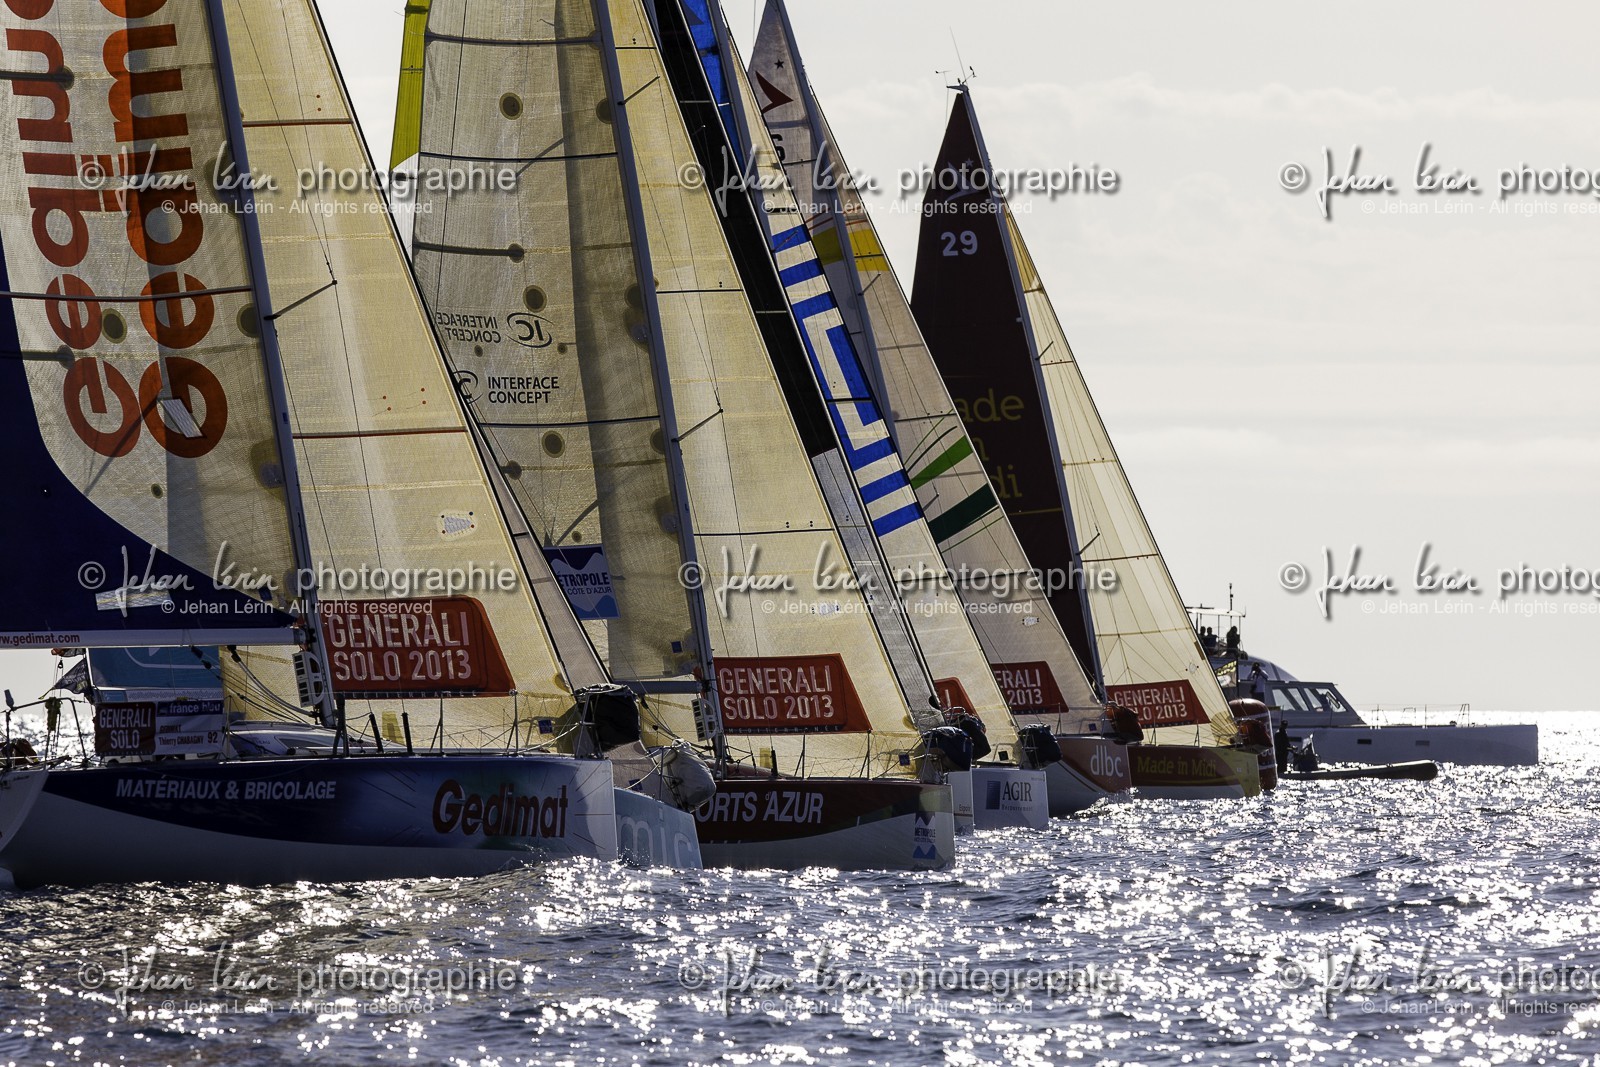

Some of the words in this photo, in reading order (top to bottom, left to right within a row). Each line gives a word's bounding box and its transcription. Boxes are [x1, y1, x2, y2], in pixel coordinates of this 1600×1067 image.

[940, 230, 978, 257] 29
[488, 376, 560, 390] INTERFACE
[488, 391, 552, 404] CONCEPT
[568, 586, 585, 596] CÔTE
[586, 586, 613, 595] D'AZUR
[327, 611, 470, 648] GENERALI
[333, 650, 401, 681] SOLO
[408, 649, 472, 680] 2013
[719, 665, 833, 695] GENERALI
[1007, 688, 1043, 706] 2013
[1113, 686, 1185, 707] GENERALI
[169, 703, 199, 714] france
[724, 696, 778, 720] SOLO
[786, 695, 835, 719] 2013
[1156, 703, 1188, 719] 2013
[99, 708, 152, 728] GENERALI
[110, 730, 140, 749] SOLO
[208, 731, 218, 744] 92
[1090, 745, 1124, 778] dlbc
[1137, 756, 1174, 775] Made
[1177, 757, 1189, 776] in
[1191, 757, 1217, 777] Midi
[225, 780, 239, 800] &
[244, 781, 337, 800] BRICOLAGE
[1002, 781, 1033, 802] AGIR
[432, 779, 569, 839] Gedimat
